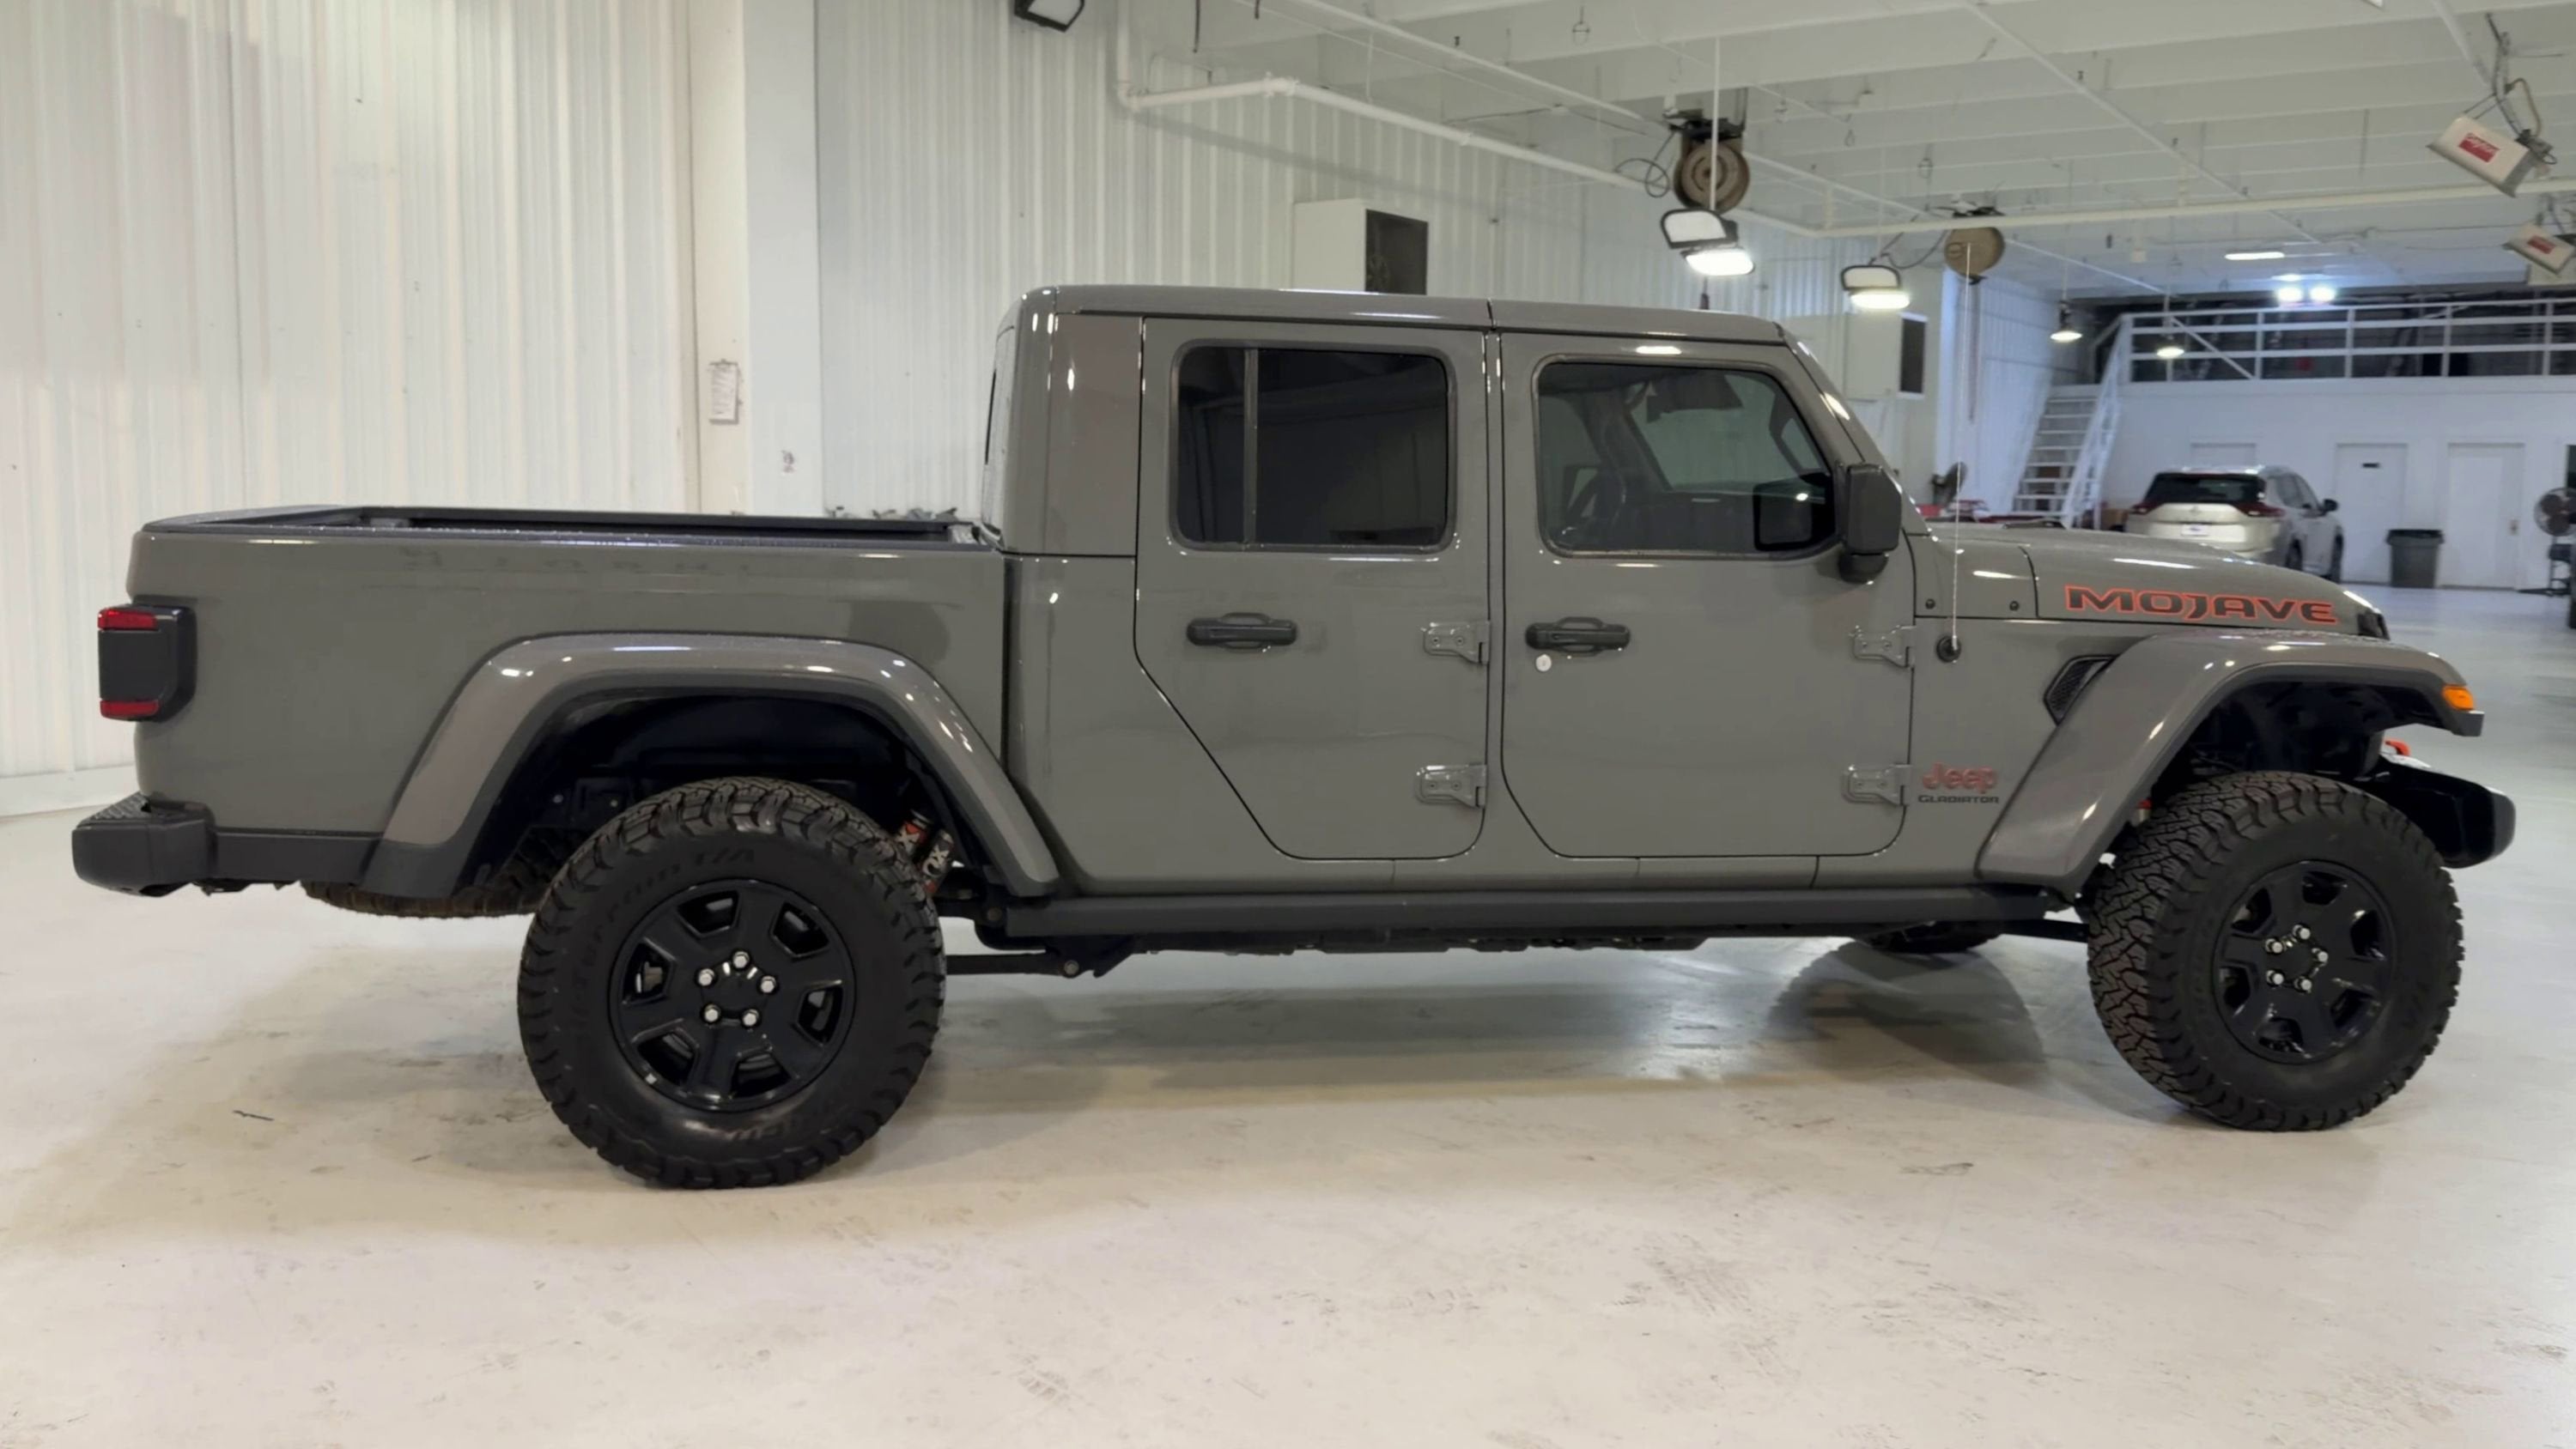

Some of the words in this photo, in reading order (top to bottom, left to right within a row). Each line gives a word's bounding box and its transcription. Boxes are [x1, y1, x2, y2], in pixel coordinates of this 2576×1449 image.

[2064, 585, 2341, 625] MOJAVE
[1922, 762, 1997, 794] Jeep
[1917, 795, 1999, 803] GLADIATOR
